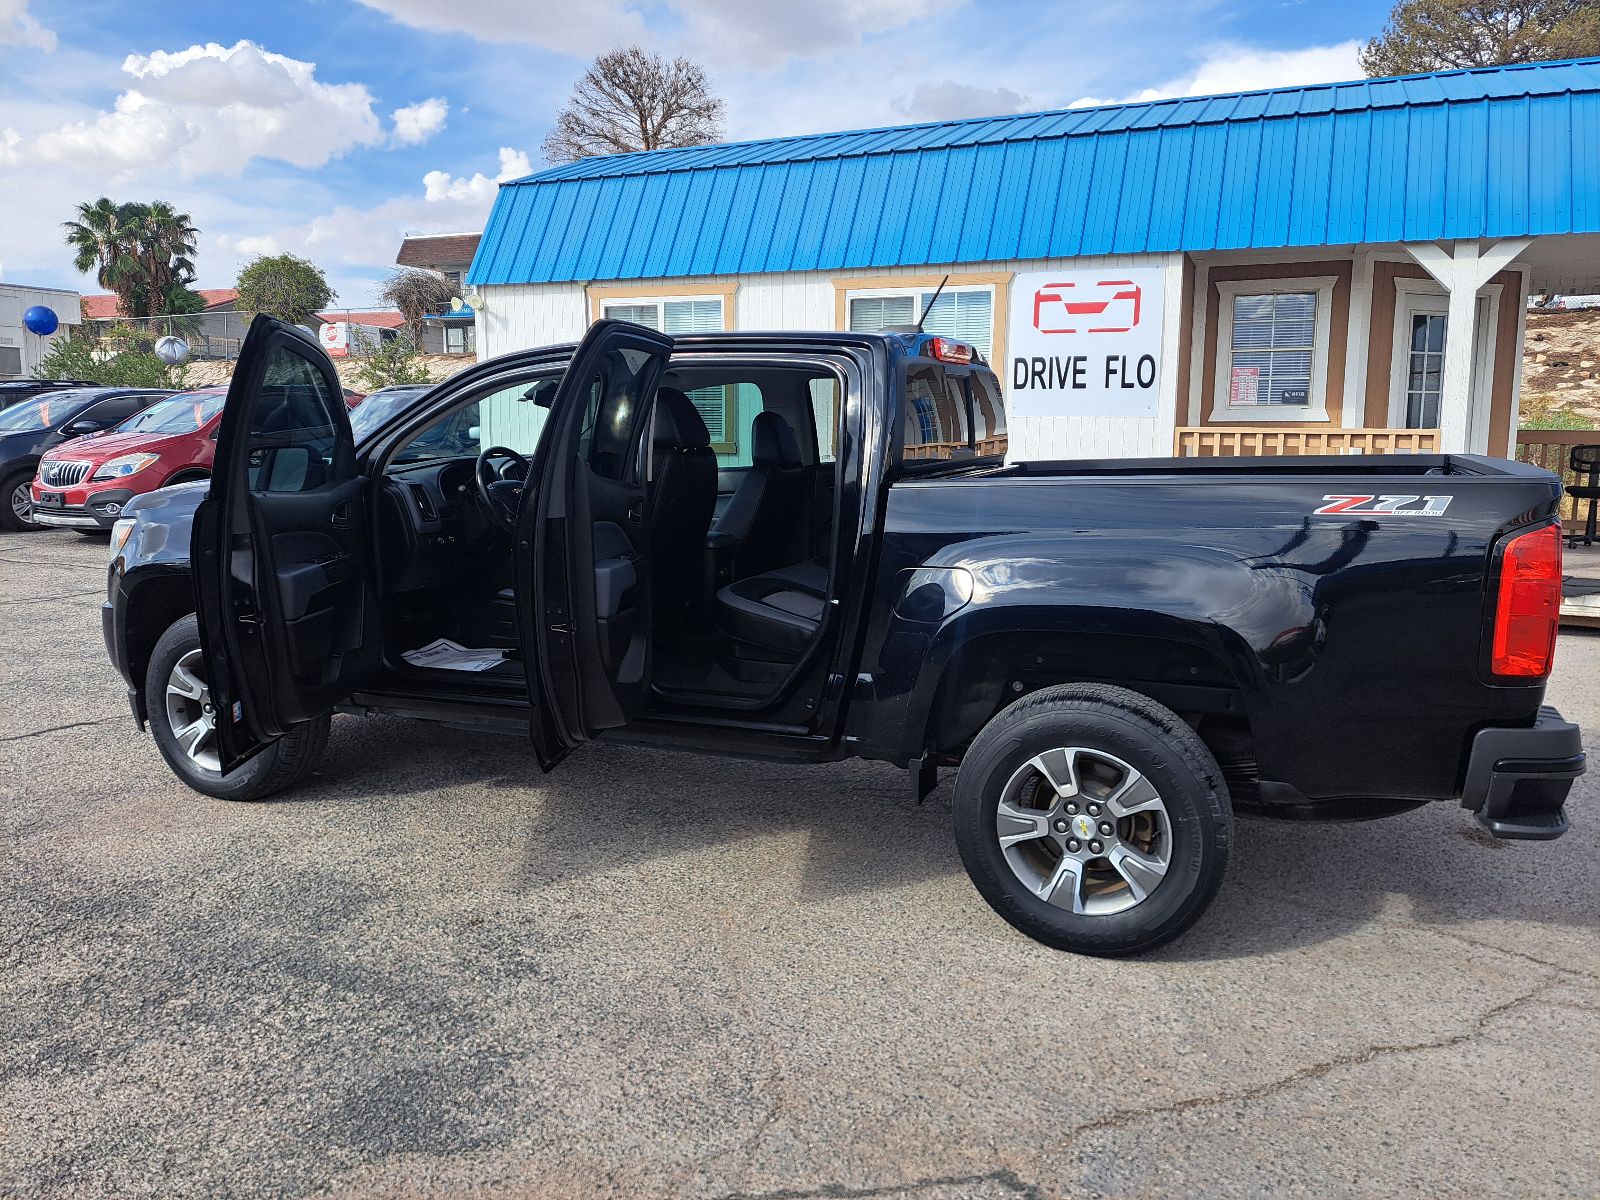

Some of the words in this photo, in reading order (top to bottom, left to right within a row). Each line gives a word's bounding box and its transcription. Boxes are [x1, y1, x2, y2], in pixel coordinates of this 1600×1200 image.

[1013, 355, 1088, 390] DRIVE
[1104, 353, 1156, 389] FLO
[1312, 494, 1454, 516] Z71
